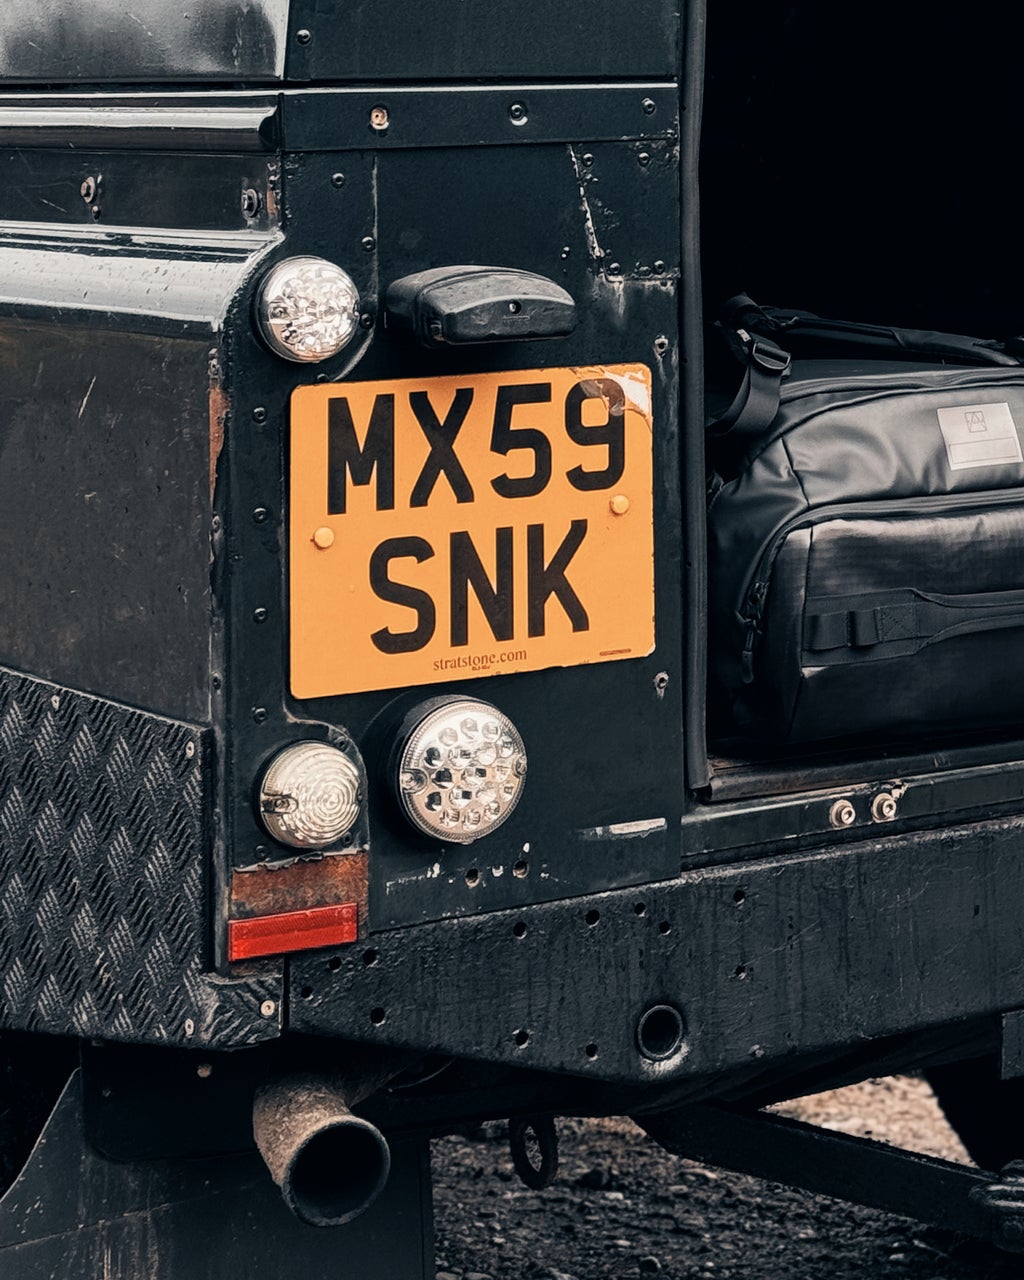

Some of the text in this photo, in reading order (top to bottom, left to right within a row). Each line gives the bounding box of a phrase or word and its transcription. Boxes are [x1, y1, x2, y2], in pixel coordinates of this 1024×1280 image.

[326, 378, 626, 516] MX59
[369, 518, 590, 656] SNK
[433, 649, 527, 671] stratstone.com
